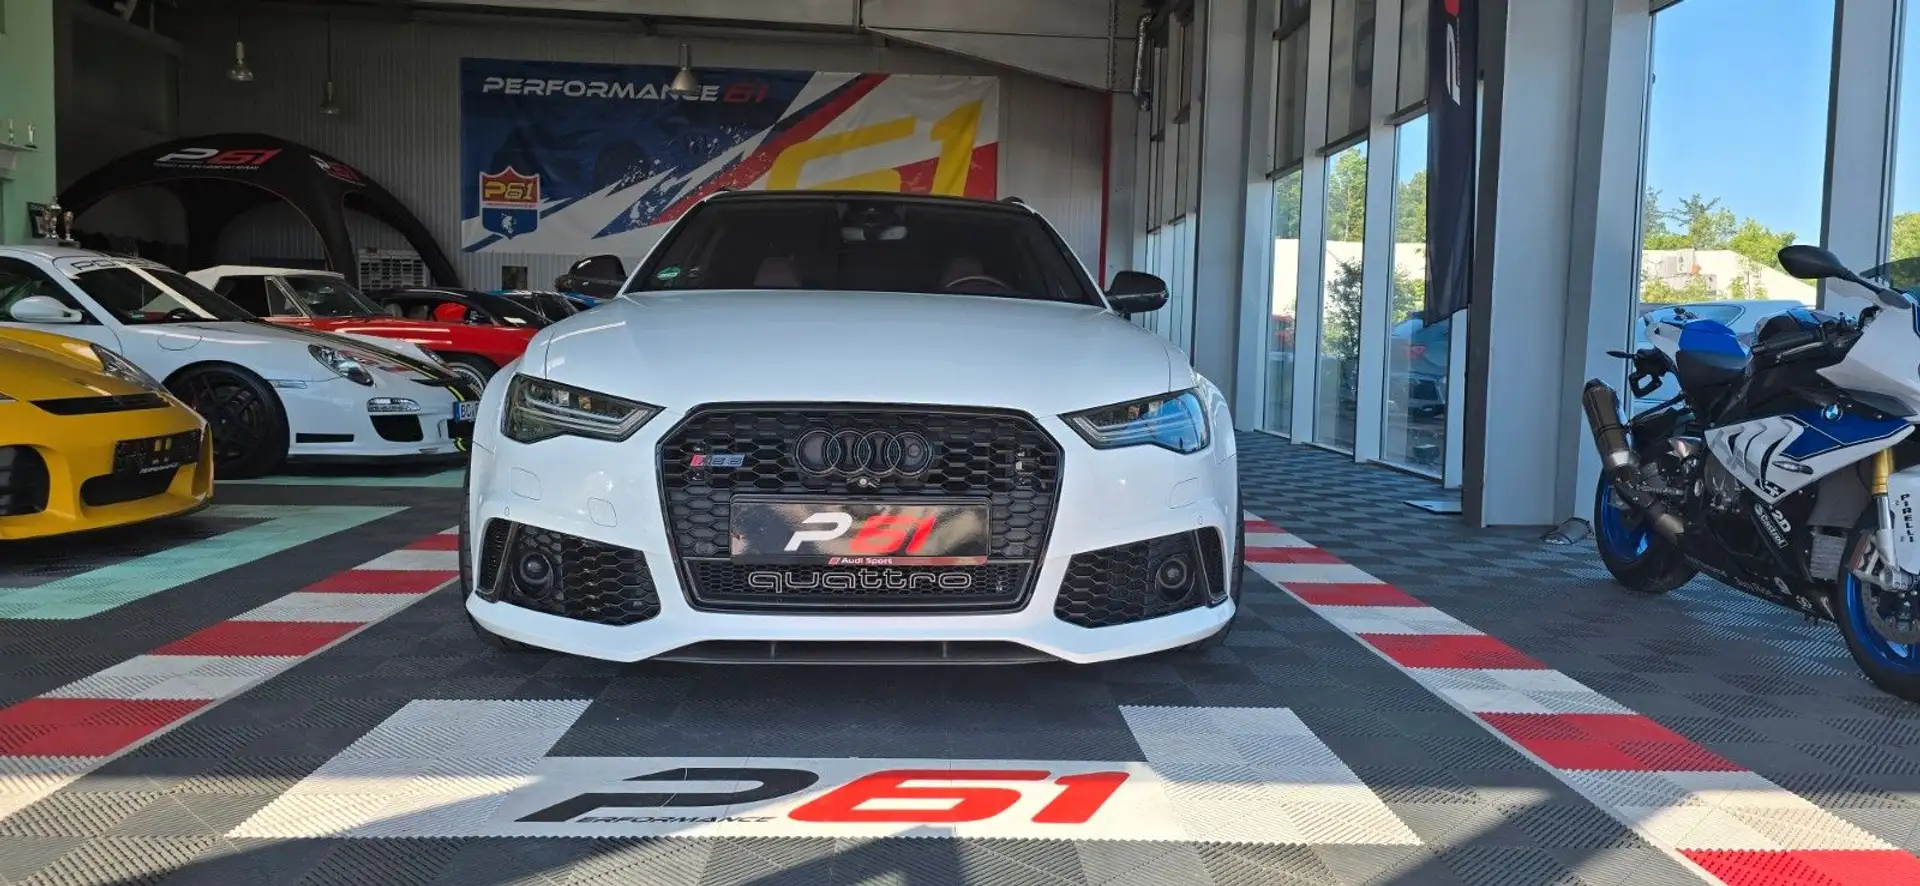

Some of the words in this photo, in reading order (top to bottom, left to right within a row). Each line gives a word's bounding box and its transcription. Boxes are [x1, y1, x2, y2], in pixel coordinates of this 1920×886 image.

[723, 83, 769, 103] 61
[157, 148, 281, 165] P61
[484, 181, 534, 200] P61
[1760, 514, 1788, 548] Castrol
[1771, 508, 1792, 534] 2D
[1900, 493, 1914, 543] PIRELLI
[784, 511, 937, 554] P61
[841, 557, 863, 565] Audi
[865, 557, 893, 566] Sport
[748, 568, 972, 594] quattro
[513, 767, 1131, 824] P61
